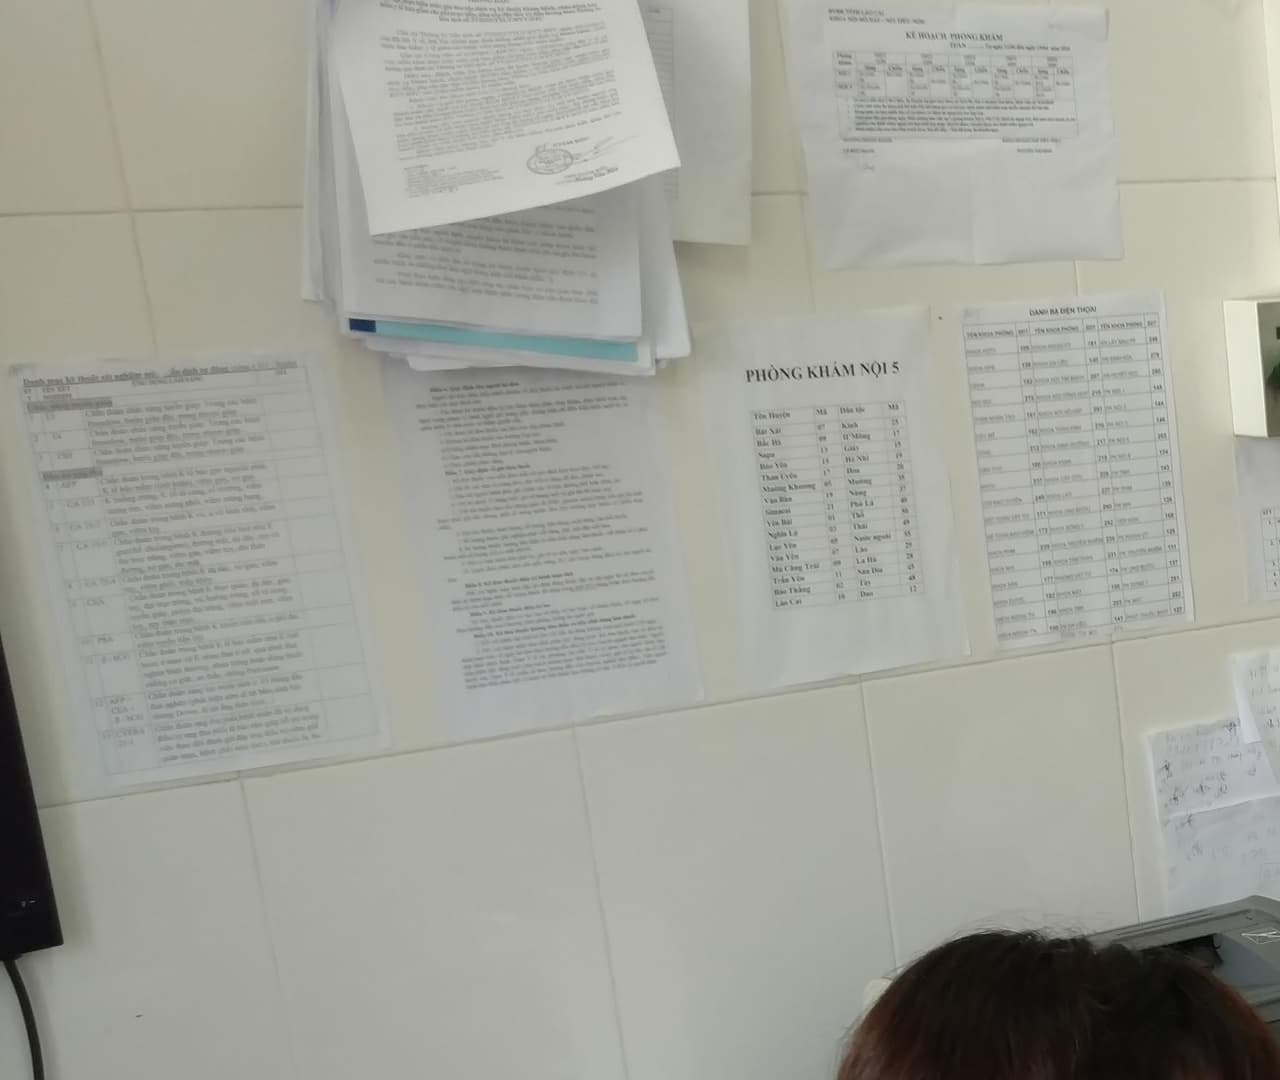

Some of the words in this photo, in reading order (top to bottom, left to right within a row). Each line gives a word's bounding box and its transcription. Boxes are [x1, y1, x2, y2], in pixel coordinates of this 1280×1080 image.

[746, 363, 802, 383] PHÒNG
[807, 360, 855, 379] KHÁM
[860, 361, 887, 379] NỘI
[892, 361, 900, 375] 5
